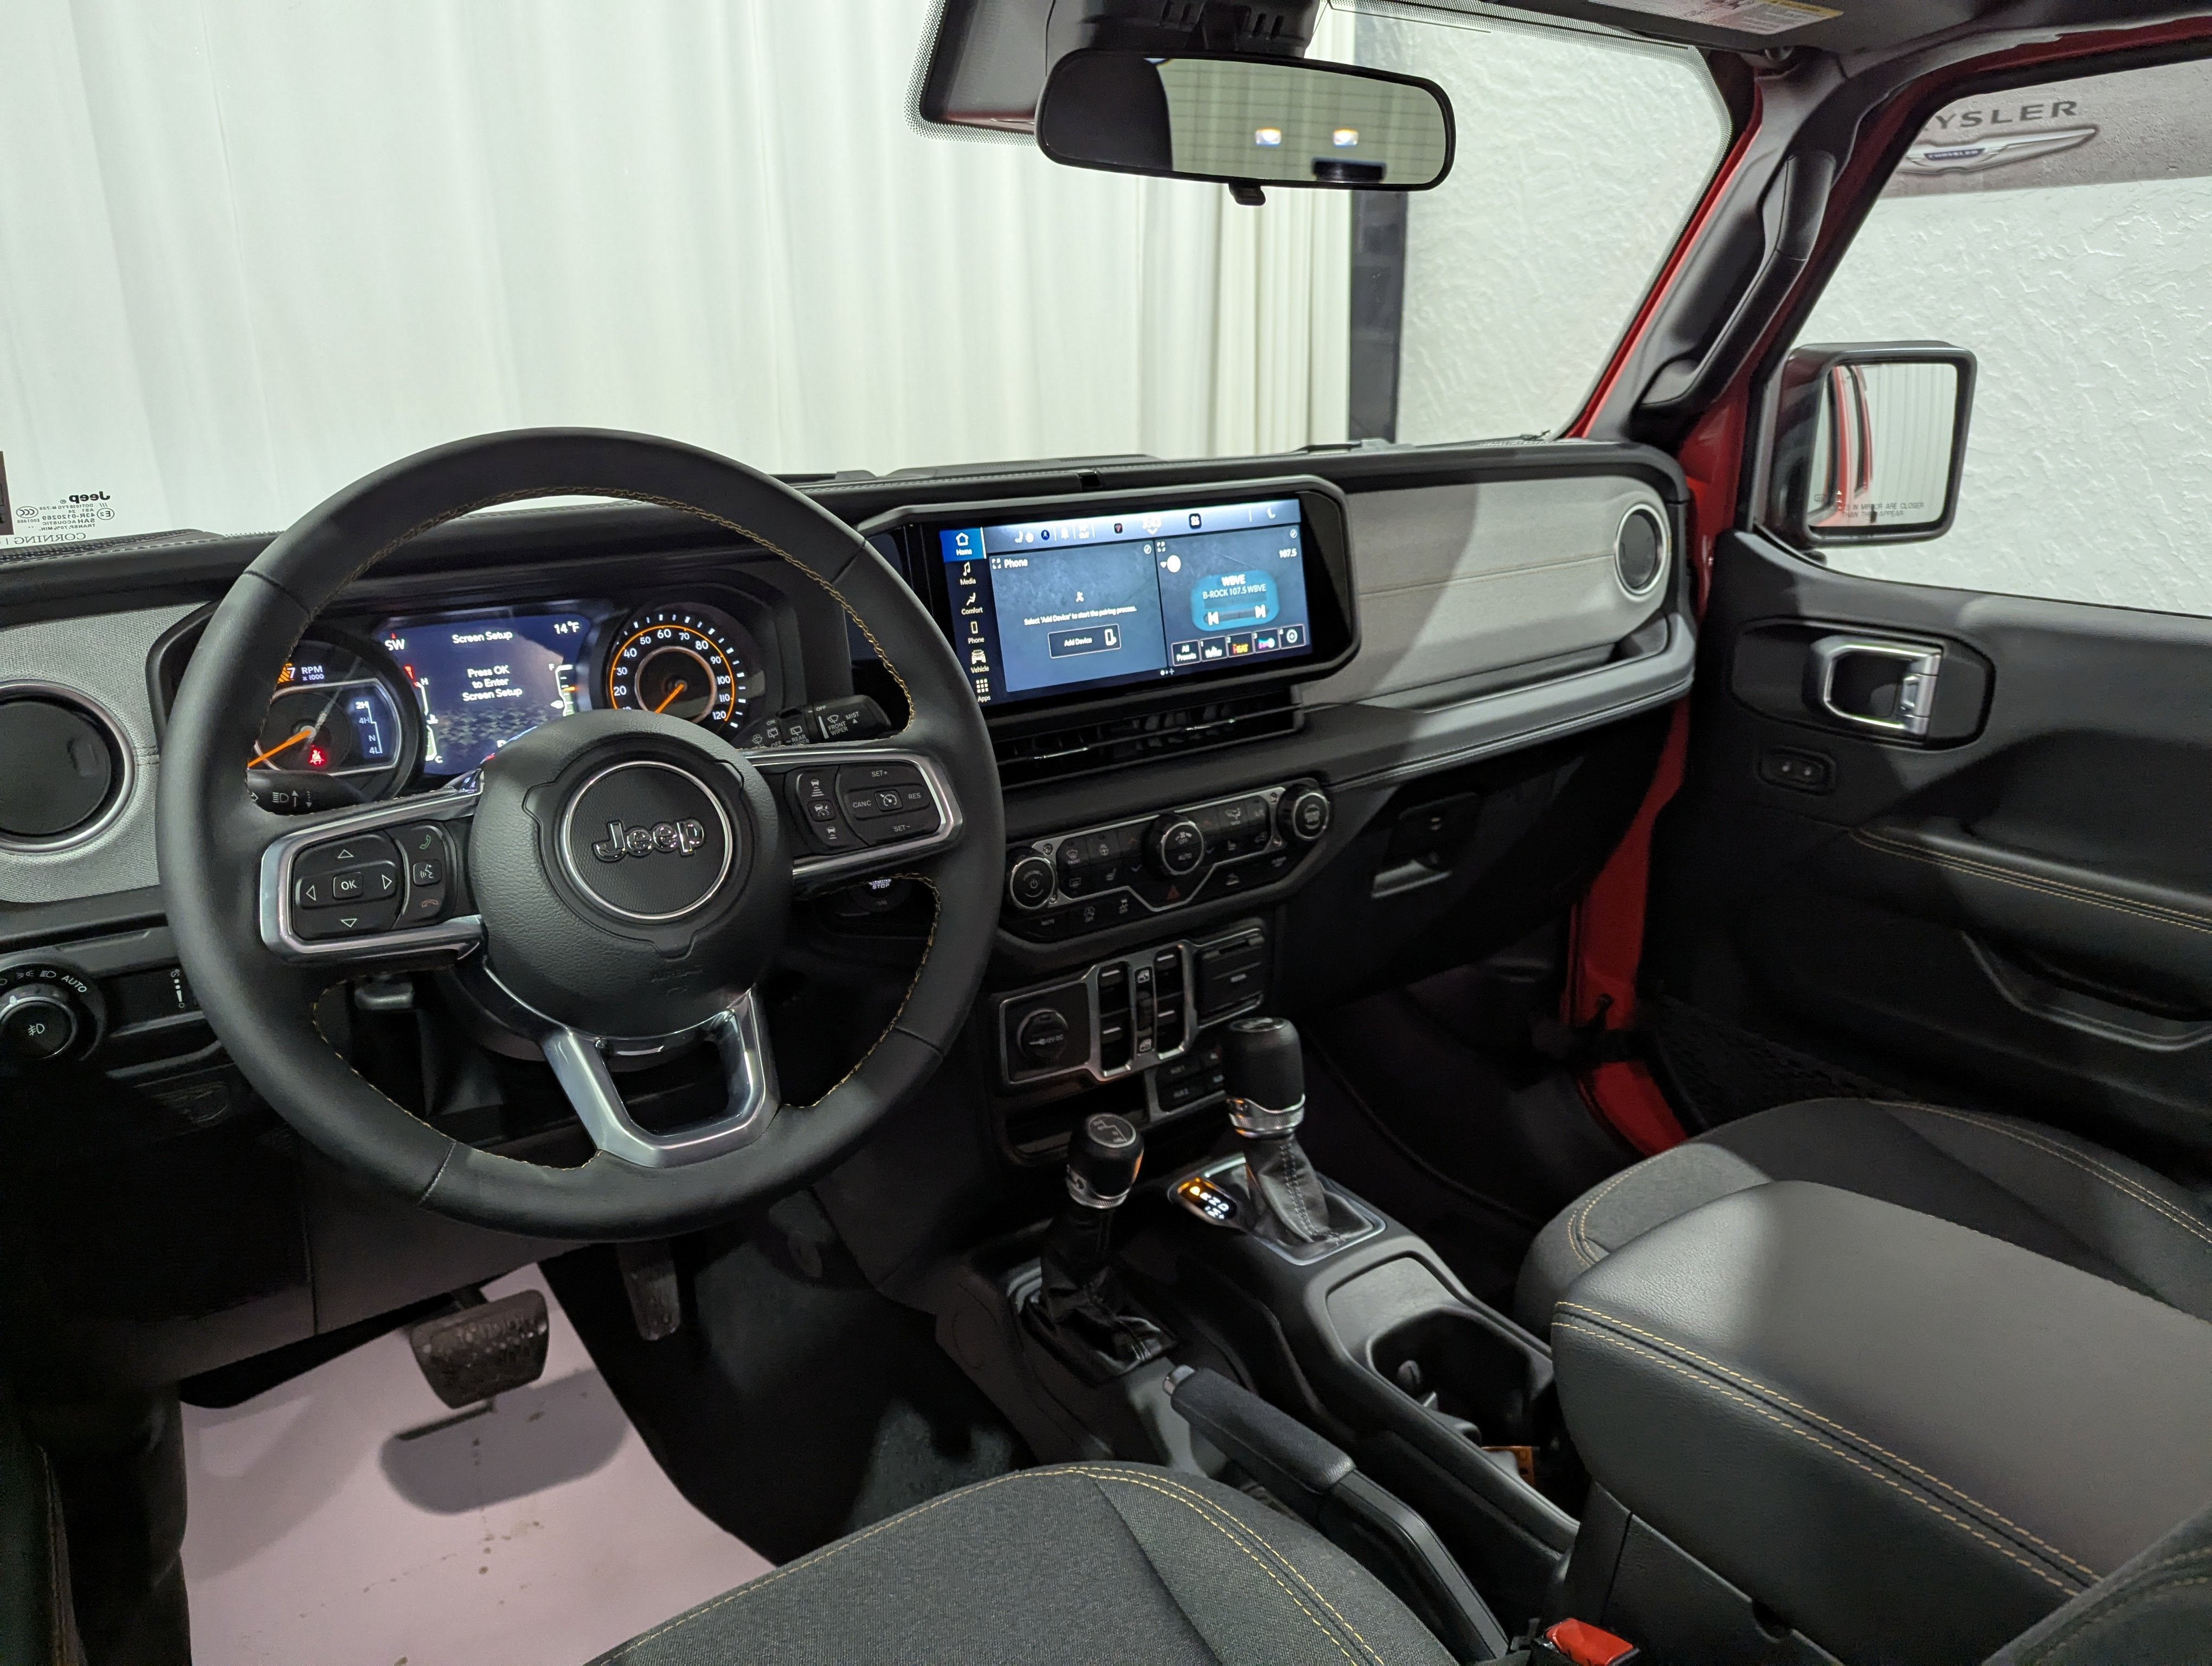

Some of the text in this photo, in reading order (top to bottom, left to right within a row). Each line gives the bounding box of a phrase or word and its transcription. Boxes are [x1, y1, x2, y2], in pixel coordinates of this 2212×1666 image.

[1924, 101, 2077, 131] YSLER
[1279, 548, 1297, 558] 107.5
[1004, 558, 1028, 568] Phone
[960, 578, 976, 586] Media
[1221, 574, 1245, 586] WBVE
[1203, 583, 1266, 599] B-ROCK 107.5 WBVE
[961, 606, 983, 615] Comfort
[1078, 611, 1090, 619] start
[1099, 608, 1117, 617] pairing
[452, 631, 513, 644] Screen Setup
[657, 629, 671, 639] 60
[679, 632, 690, 640] 70
[384, 639, 405, 651] SW
[640, 636, 652, 645] 50
[695, 640, 709, 650] 80
[1075, 637, 1092, 645] Device
[623, 648, 637, 658] 40
[1181, 645, 1190, 653] All
[710, 656, 721, 664] 90
[1176, 653, 1197, 662] Presets
[301, 665, 323, 675] RPM
[467, 665, 510, 678] Press OK
[616, 667, 628, 676] 30
[970, 665, 989, 674] Vehicle
[484, 678, 509, 688] Enter
[717, 676, 730, 685] 100
[462, 688, 523, 701] Screen Setup
[614, 685, 627, 696] 20
[719, 694, 730, 702] 110
[978, 695, 991, 703] Apps
[712, 711, 726, 720] 120
[846, 711, 859, 720] MIST
[828, 721, 846, 731] FRONT
[830, 726, 848, 736] WIPER
[792, 734, 807, 742] REAR
[853, 800, 871, 809] CANC
[593, 818, 705, 862] Jeep
[341, 880, 357, 890] OK
[61, 975, 87, 993] AUTO
